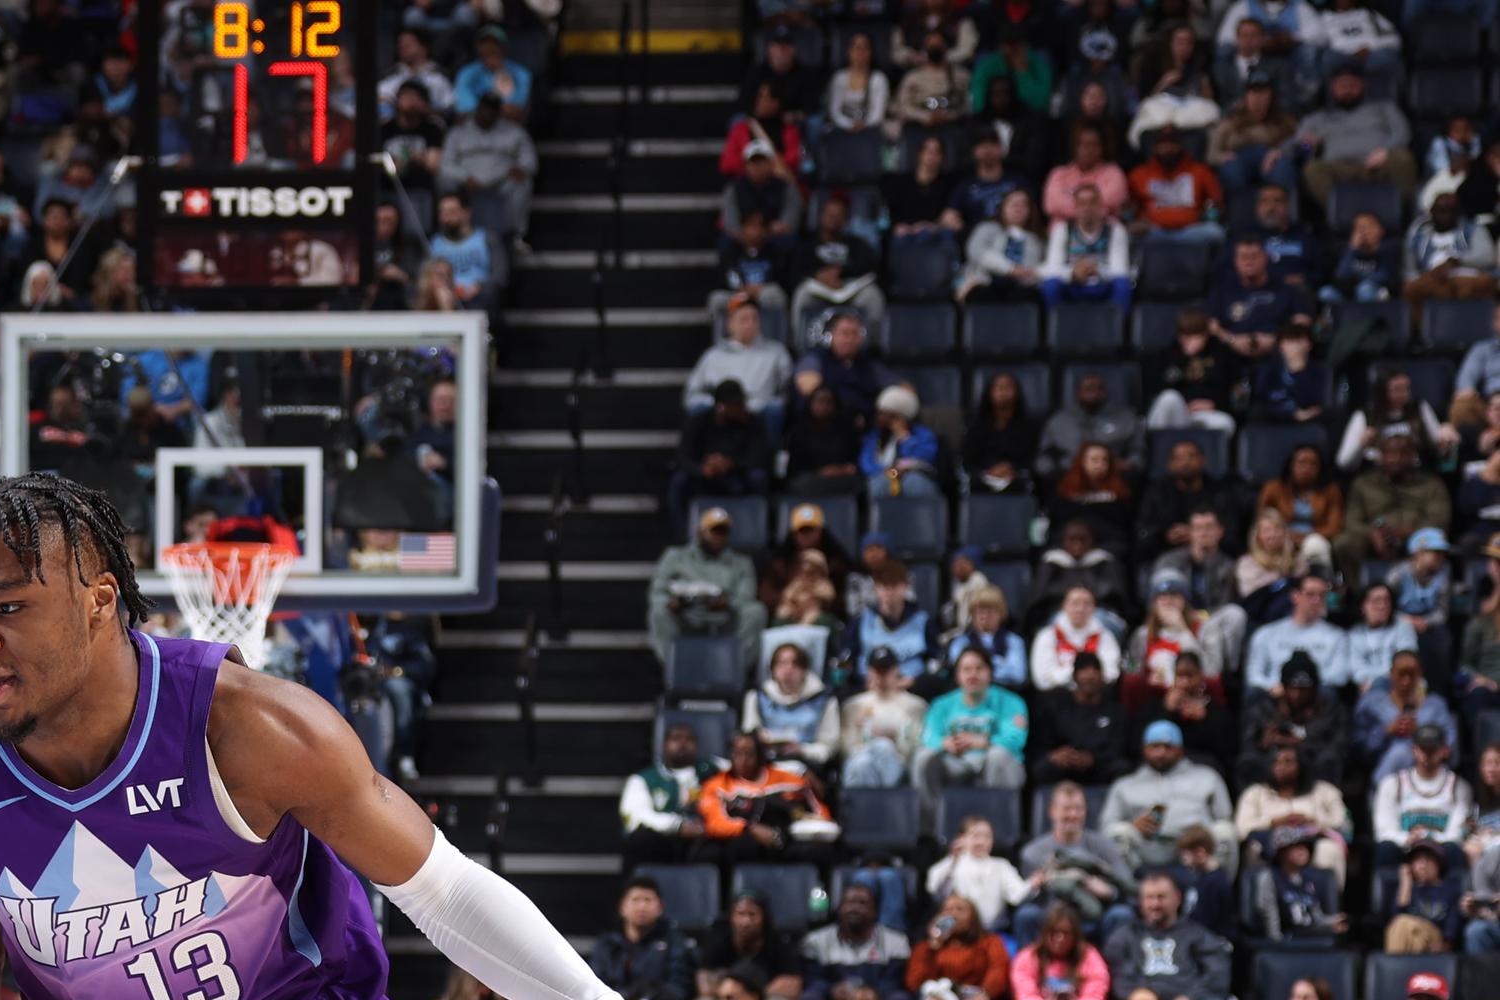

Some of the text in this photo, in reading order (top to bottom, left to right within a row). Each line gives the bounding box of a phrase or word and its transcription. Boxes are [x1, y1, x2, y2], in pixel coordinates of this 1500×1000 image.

[213, 1, 341, 58] 8:12
[232, 61, 328, 165] 17
[213, 187, 352, 216] TISSOT
[126, 777, 184, 815] LVT
[0, 876, 210, 968] UTAH
